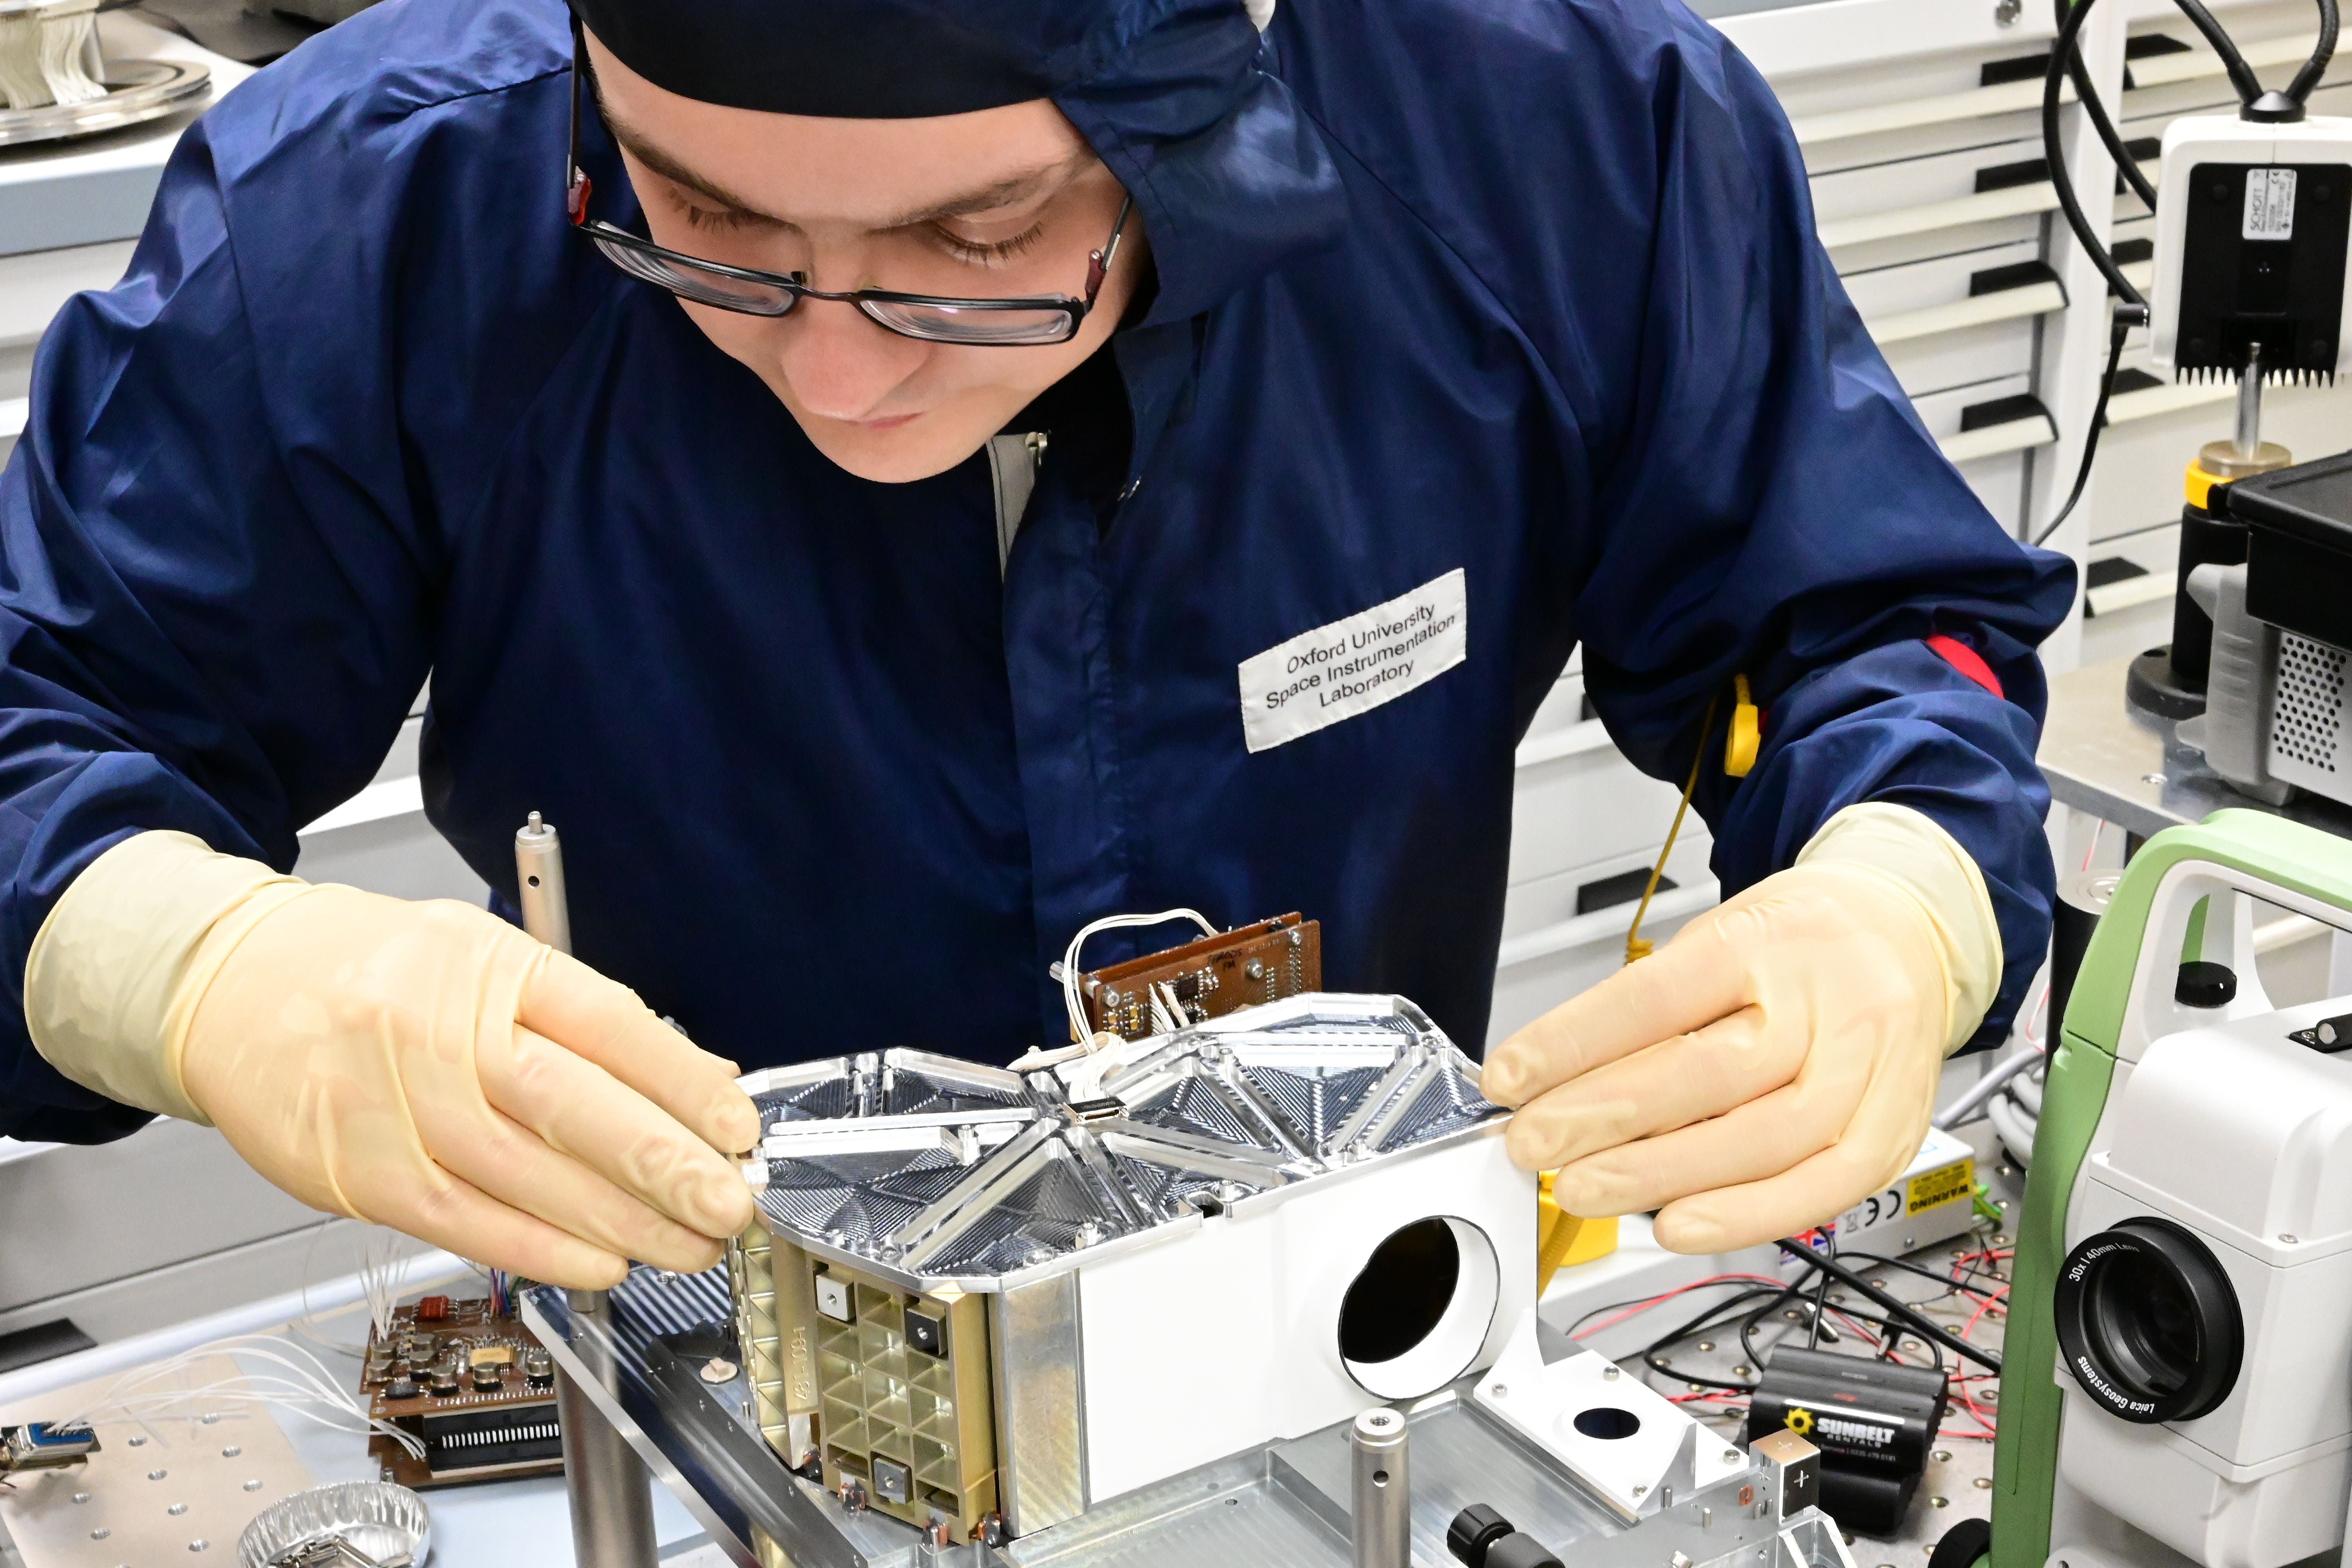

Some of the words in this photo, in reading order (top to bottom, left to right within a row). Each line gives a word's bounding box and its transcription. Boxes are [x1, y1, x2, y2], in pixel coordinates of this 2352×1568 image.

[1266, 675, 1320, 709] Space
[1328, 614, 1455, 680] Instrumentation
[1287, 638, 1345, 674] Oxford
[1352, 603, 1435, 648] University
[1320, 661, 1414, 707] Laboratory
[1909, 1184, 1968, 1212] WARNING
[2069, 1264, 2087, 1282] 30x
[2087, 1244, 2117, 1260] 40mm
[2115, 1242, 2140, 1253] Lens
[790, 1326, 810, 1400] 481-109-1
[2078, 1356, 2129, 1410] Geosystems
[2129, 1401, 2155, 1414] Leica
[1817, 1418, 1895, 1444] SUNBELT
